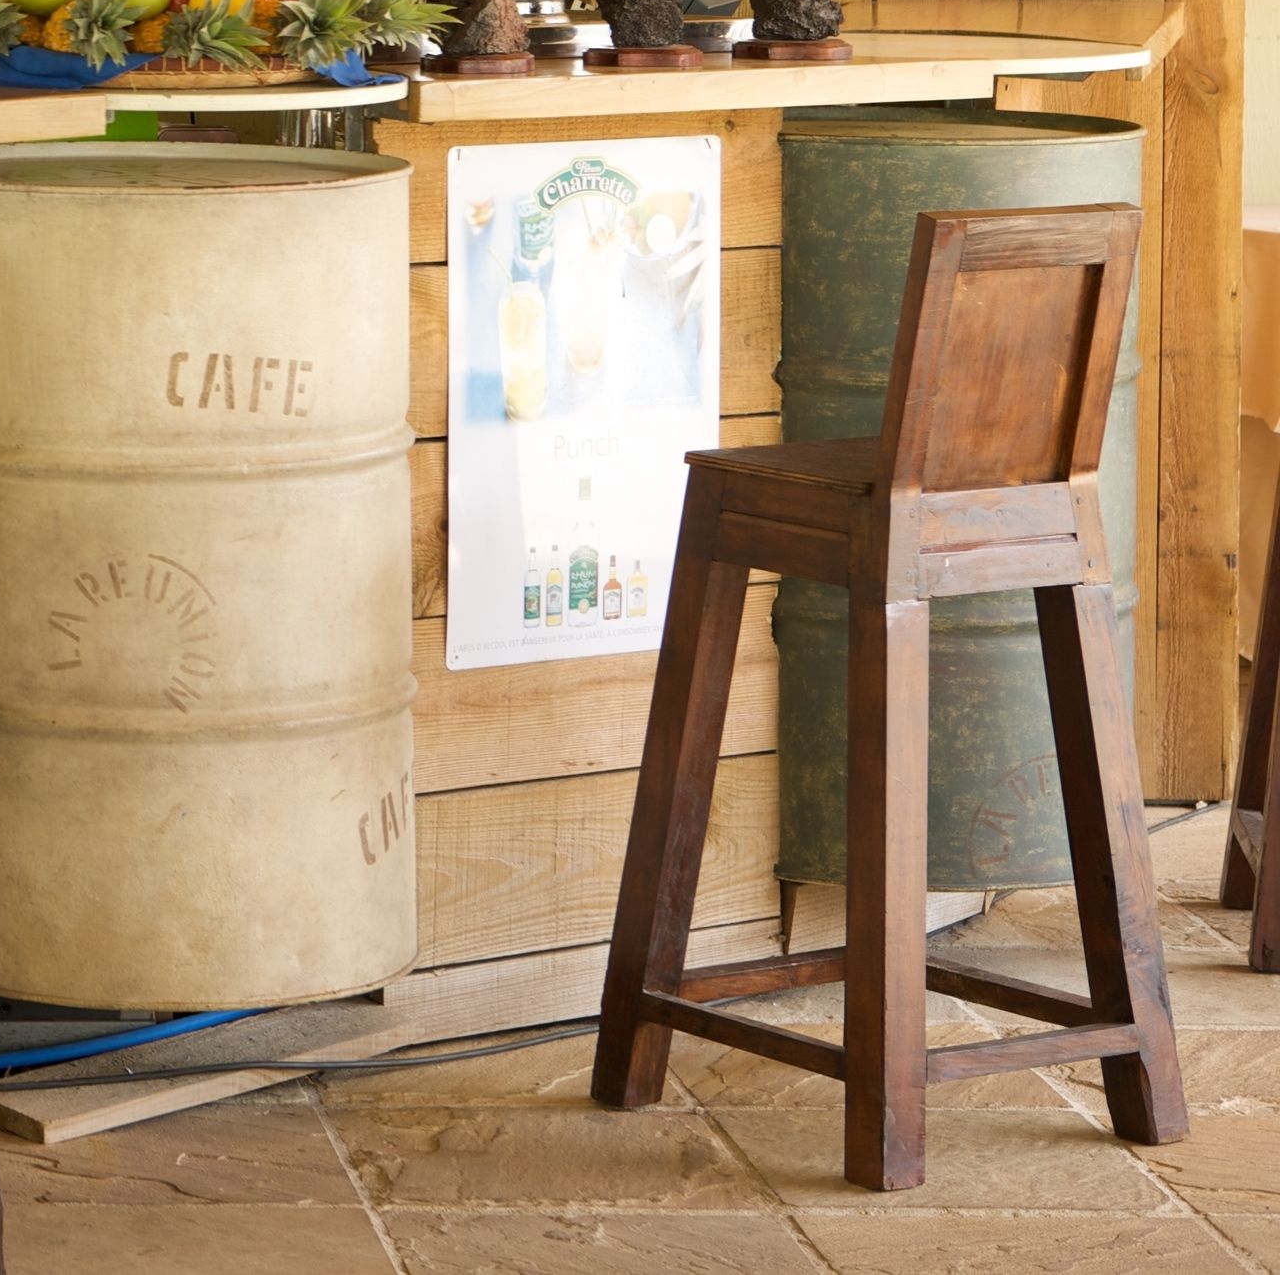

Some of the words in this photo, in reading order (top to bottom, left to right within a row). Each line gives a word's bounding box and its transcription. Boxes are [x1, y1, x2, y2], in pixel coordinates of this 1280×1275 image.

[543, 176, 632, 205] Charrette
[166, 352, 313, 417] CAFE
[553, 428, 620, 461] Punch
[47, 610, 88, 671] LA
